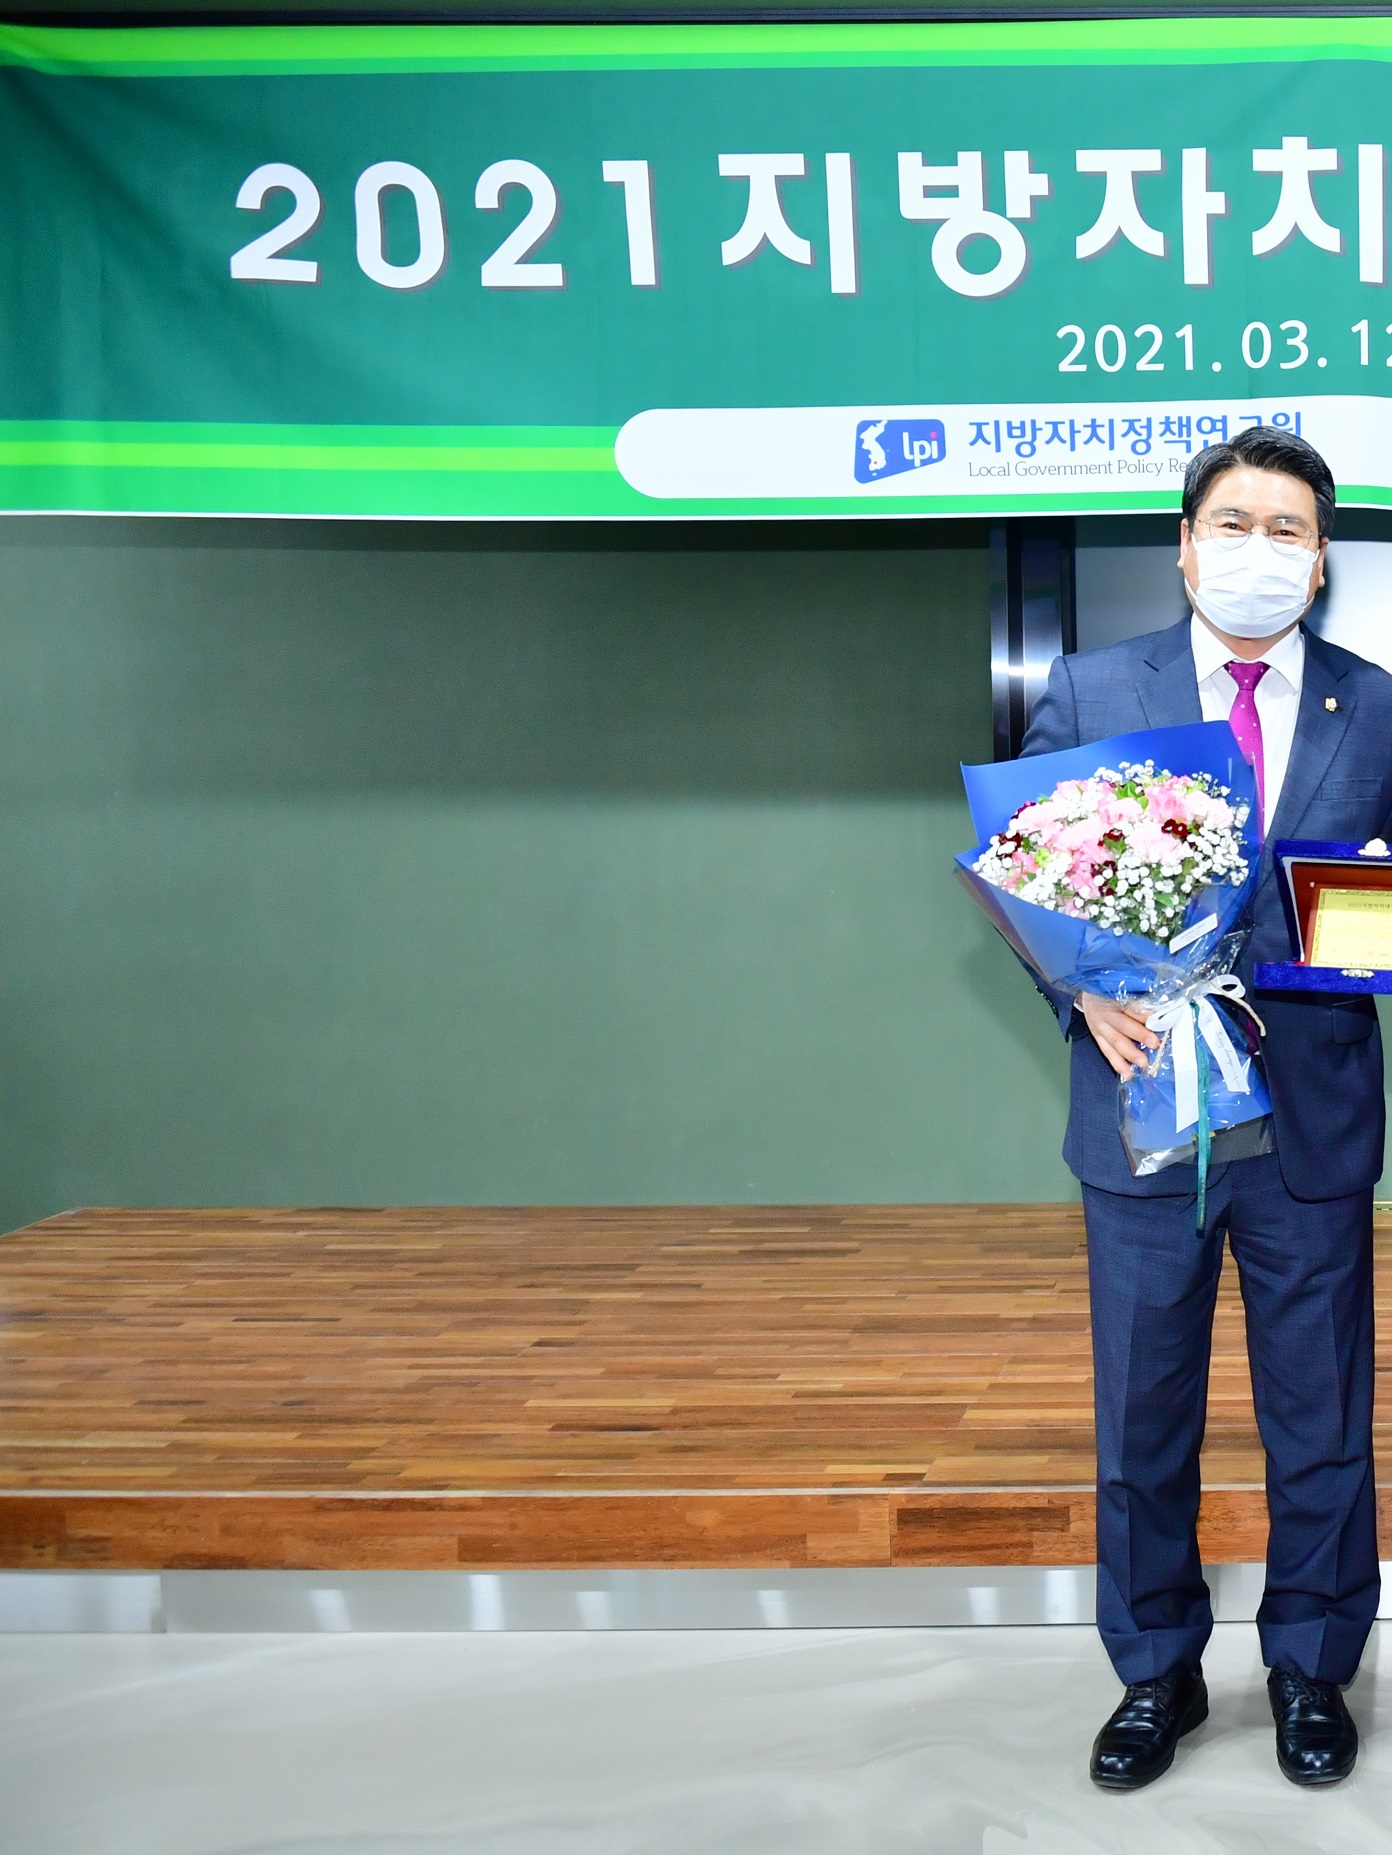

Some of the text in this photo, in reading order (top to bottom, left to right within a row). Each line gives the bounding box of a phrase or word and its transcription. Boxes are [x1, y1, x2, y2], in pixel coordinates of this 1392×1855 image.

[230, 159, 657, 290] 2021
[1055, 323, 1223, 374] 2021.
[1240, 318, 1328, 370] 03.
[902, 432, 939, 467] lpi
[968, 461, 1010, 477] Local
[1014, 460, 1114, 477] Government
[1117, 459, 1165, 477] Policy
